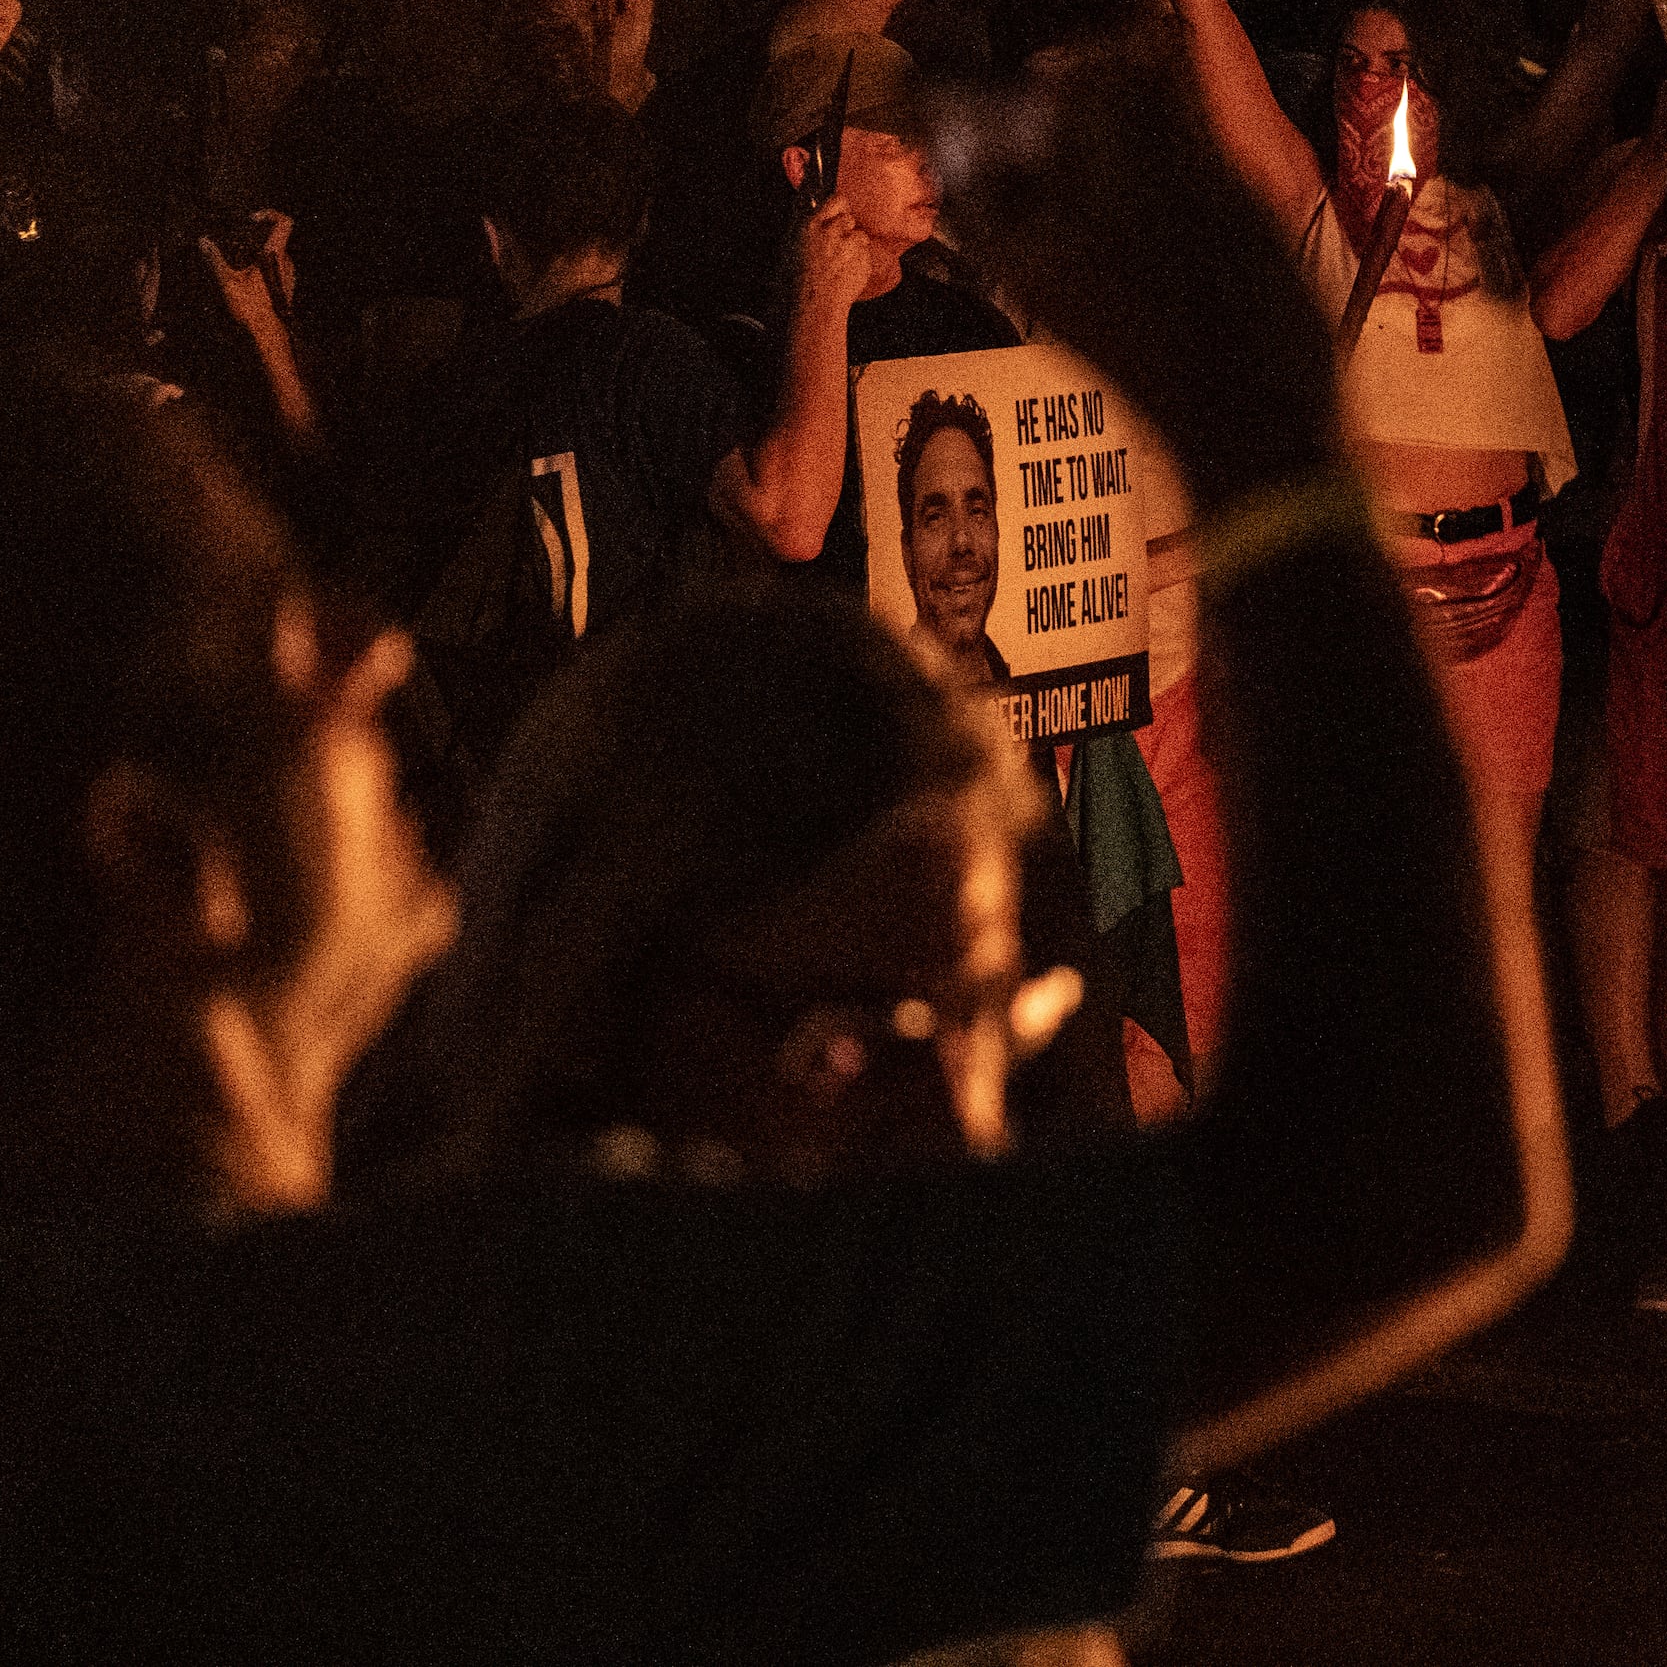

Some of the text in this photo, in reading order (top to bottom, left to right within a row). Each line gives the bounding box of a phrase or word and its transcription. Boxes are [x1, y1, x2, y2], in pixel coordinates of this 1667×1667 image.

[1015, 389, 1104, 446] HE HAS NO
[1019, 447, 1132, 509] TIME TO WAIT.
[1023, 512, 1111, 572] BRING HIM
[1026, 571, 1129, 635] HOME ALIVE!
[1038, 681, 1088, 738] HOME
[1090, 673, 1130, 727] NOW!
